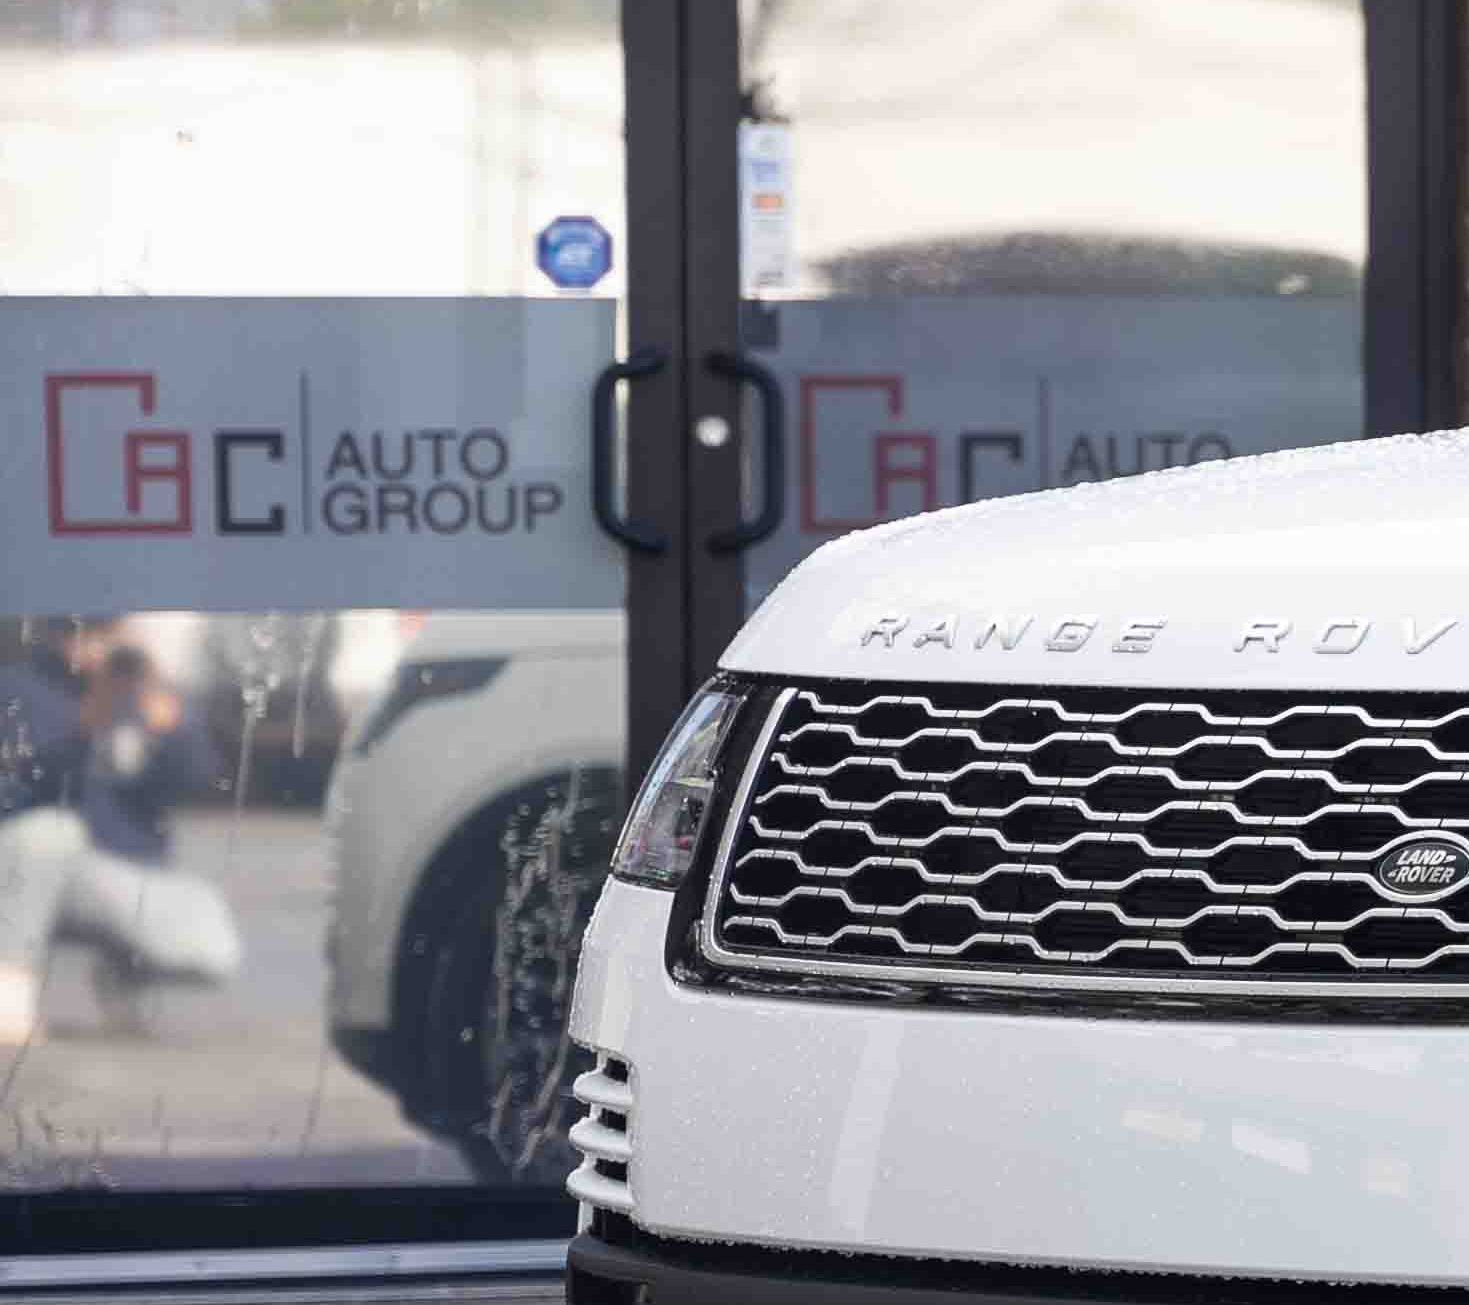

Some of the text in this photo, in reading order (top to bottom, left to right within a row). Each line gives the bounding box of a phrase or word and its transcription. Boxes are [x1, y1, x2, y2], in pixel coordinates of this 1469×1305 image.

[323, 428, 509, 482] AUTO
[321, 482, 565, 535] GROUP
[859, 614, 1168, 653] RANGE
[1395, 866, 1455, 883] ROVER
[1397, 849, 1447, 865] LAND
